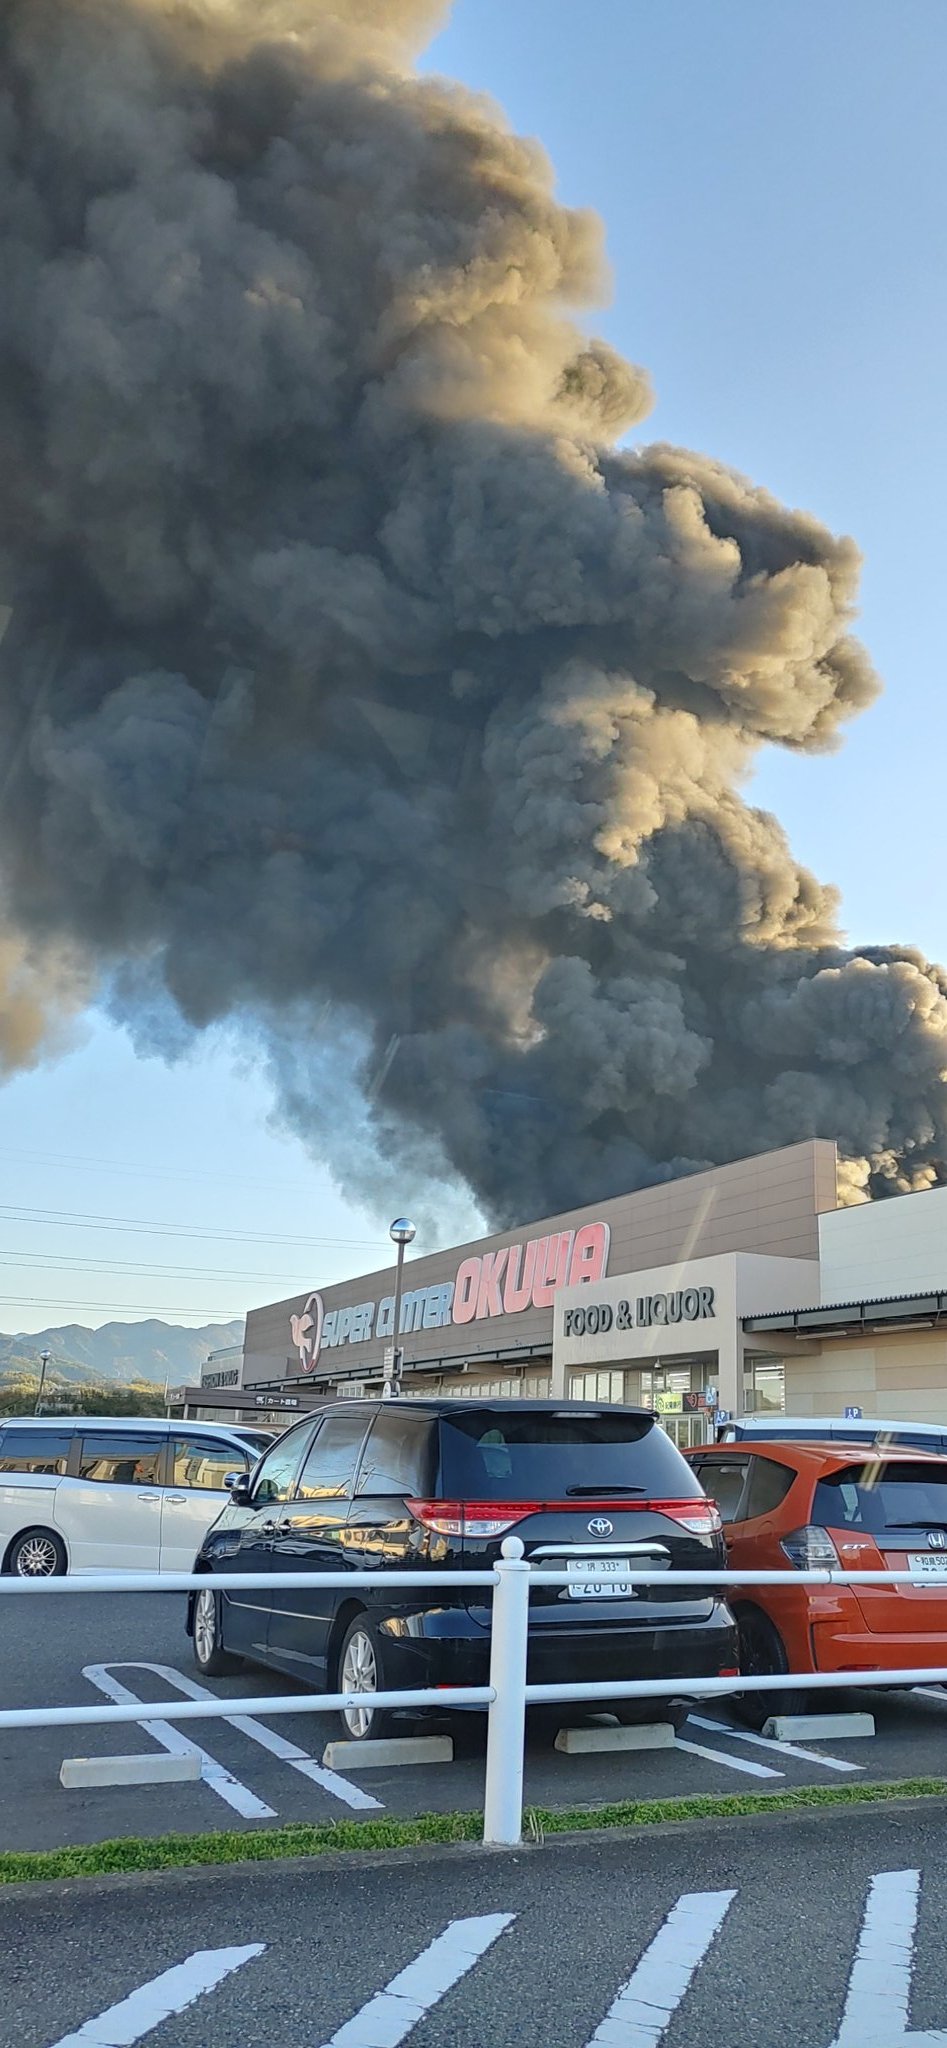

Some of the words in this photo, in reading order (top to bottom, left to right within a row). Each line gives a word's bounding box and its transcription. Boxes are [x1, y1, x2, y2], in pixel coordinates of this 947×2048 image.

[320, 1301, 376, 1350] SUPER
[452, 1221, 611, 1325] OKUWA
[563, 1303, 613, 1337] FOOD
[616, 1300, 633, 1330] &
[636, 1286, 715, 1327] LIQUOR
[600, 1562, 616, 1572] 333
